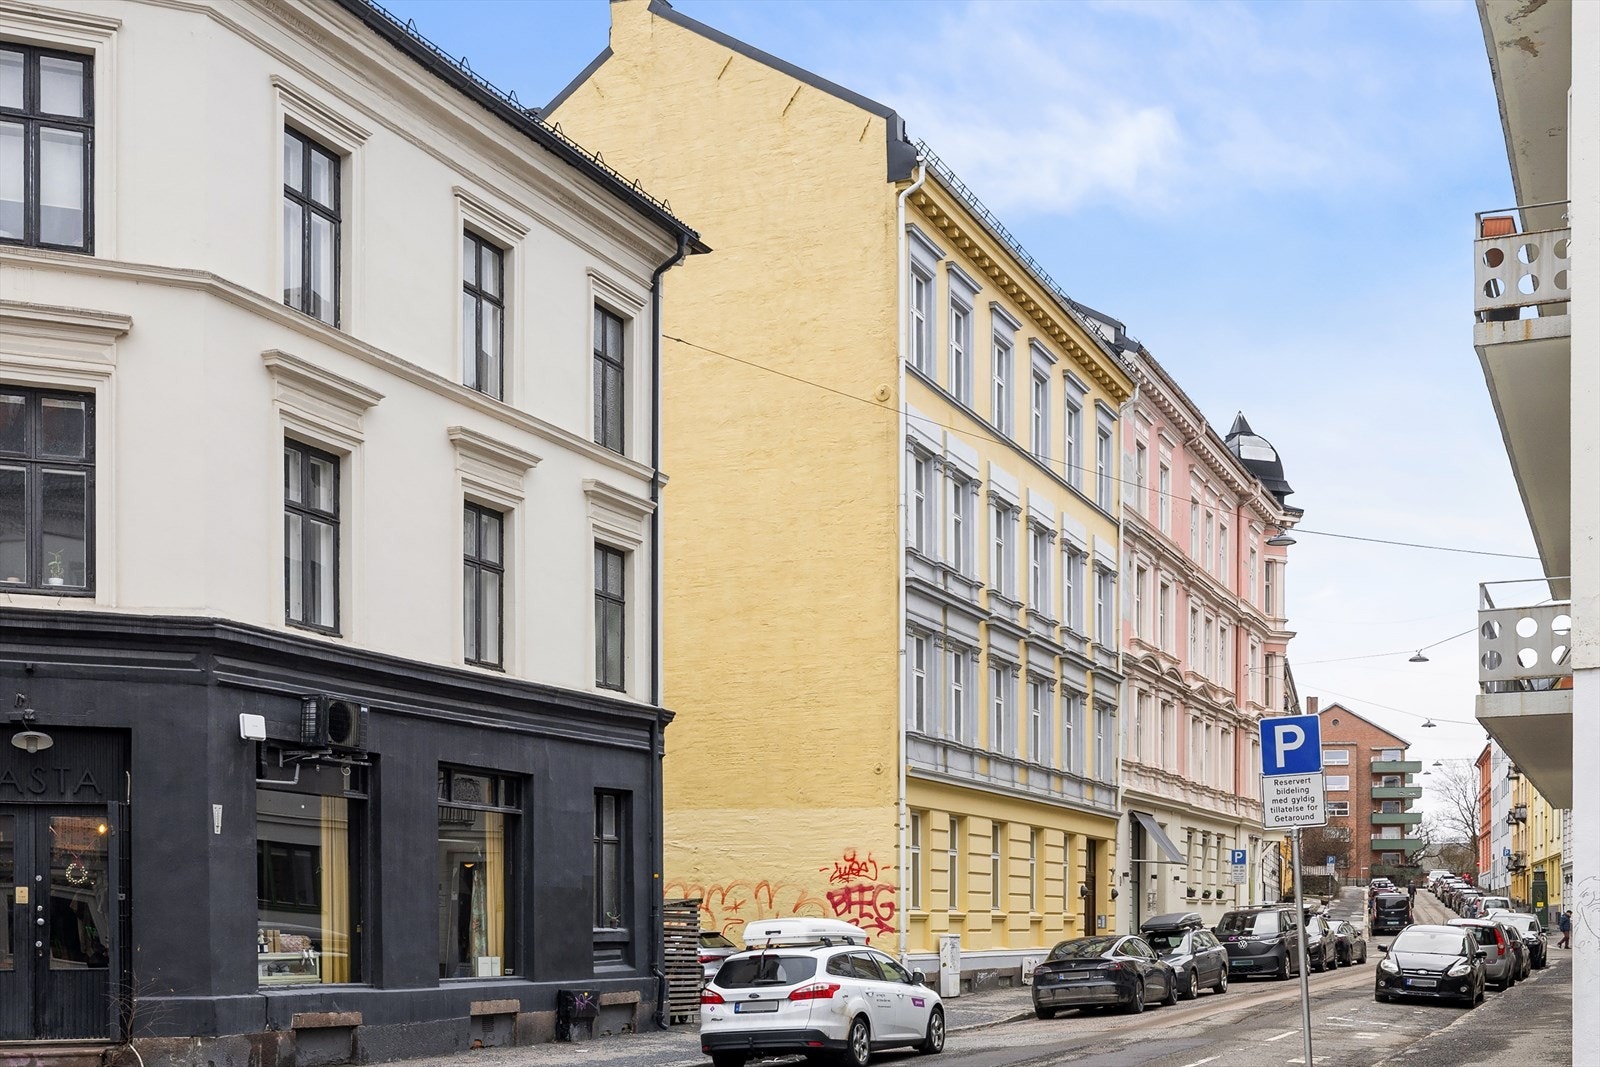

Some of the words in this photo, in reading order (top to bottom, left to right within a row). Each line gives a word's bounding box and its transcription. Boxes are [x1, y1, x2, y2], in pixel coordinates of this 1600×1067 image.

[1274, 724, 1306, 768] P
[1274, 777, 1311, 786] Reservert
[1276, 787, 1310, 795] bildeling
[1271, 796, 1288, 804] med
[1291, 795, 1315, 804] gyldig
[1270, 804, 1304, 813] tillatelse
[1307, 803, 1318, 811] for
[1274, 813, 1315, 822] Getaround
[1234, 851, 1243, 863] P
